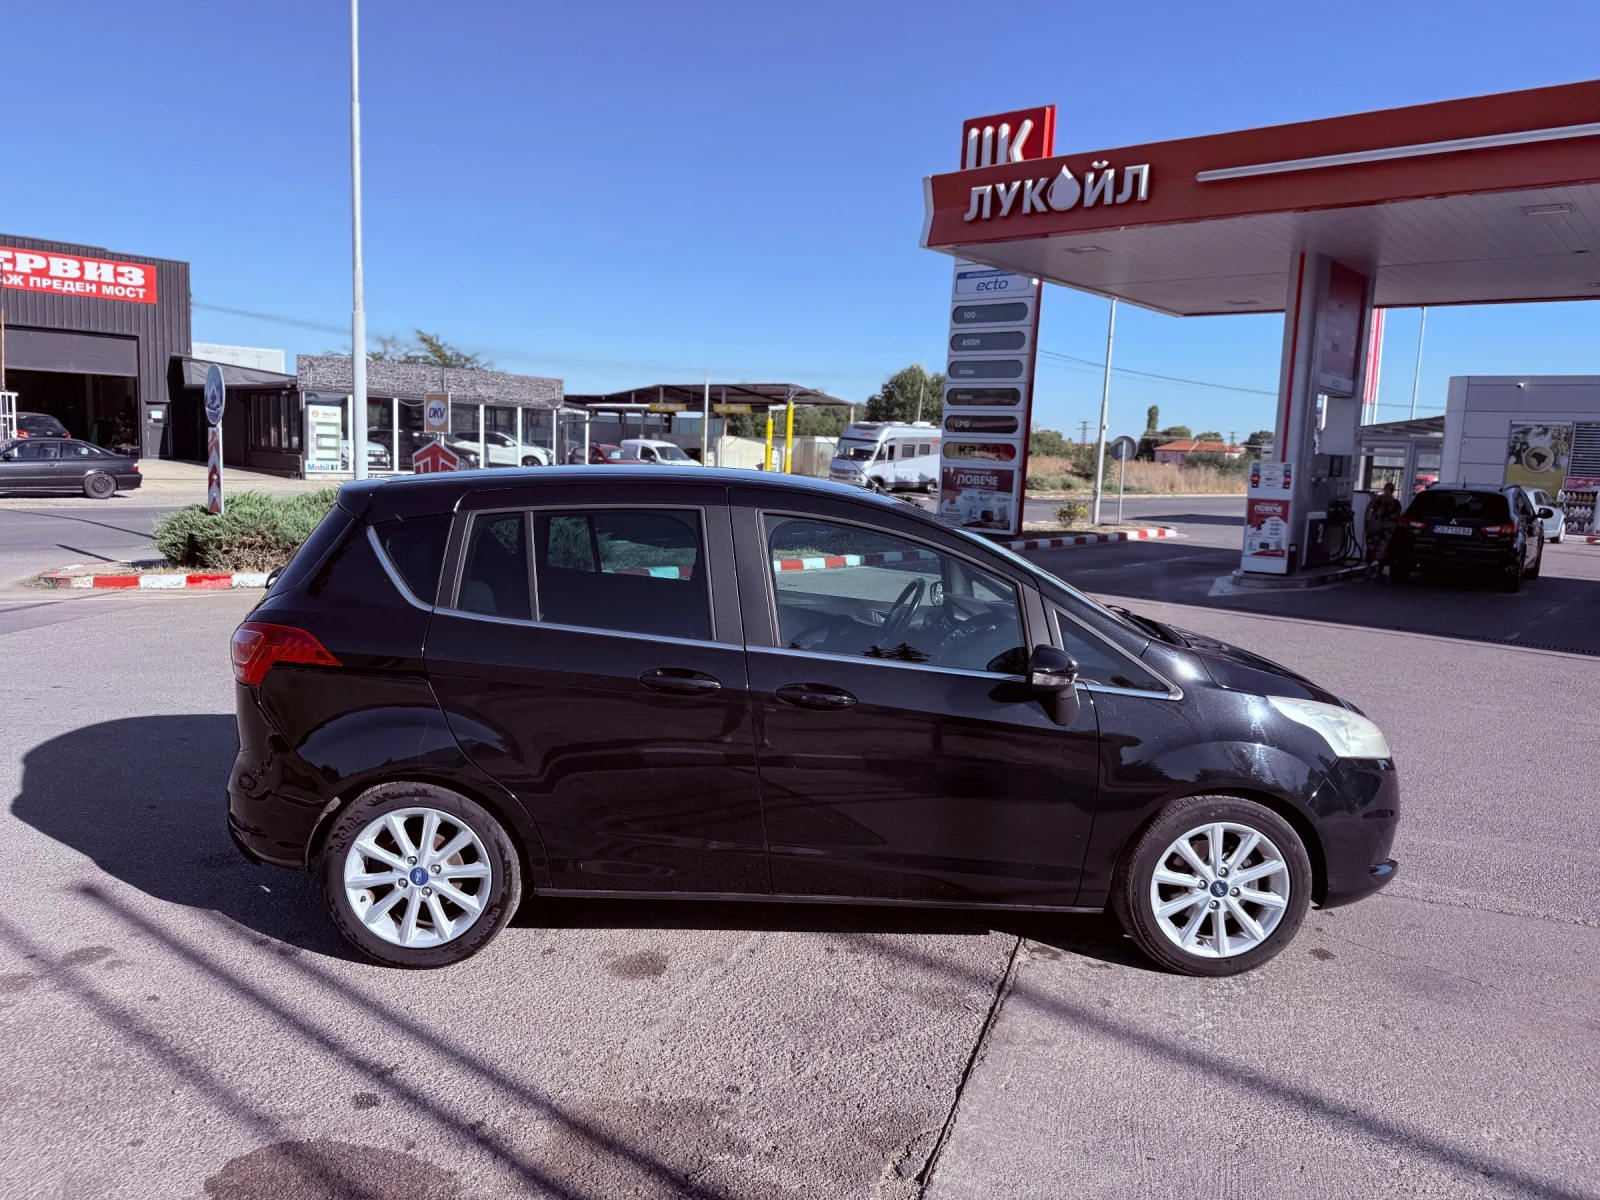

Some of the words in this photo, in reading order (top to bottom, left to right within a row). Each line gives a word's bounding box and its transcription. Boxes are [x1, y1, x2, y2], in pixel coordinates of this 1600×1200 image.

[964, 160, 1150, 222] ЛУКОЙЛ
[29, 276, 97, 293] ПРЕДЕН
[102, 285, 146, 299] МОСТ
[976, 278, 1008, 292] ecto
[963, 311, 976, 319] 100
[428, 407, 446, 419] DKV
[955, 420, 970, 428] LPG
[307, 463, 330, 471] Mobil
[1316, 523, 1324, 544] 2
